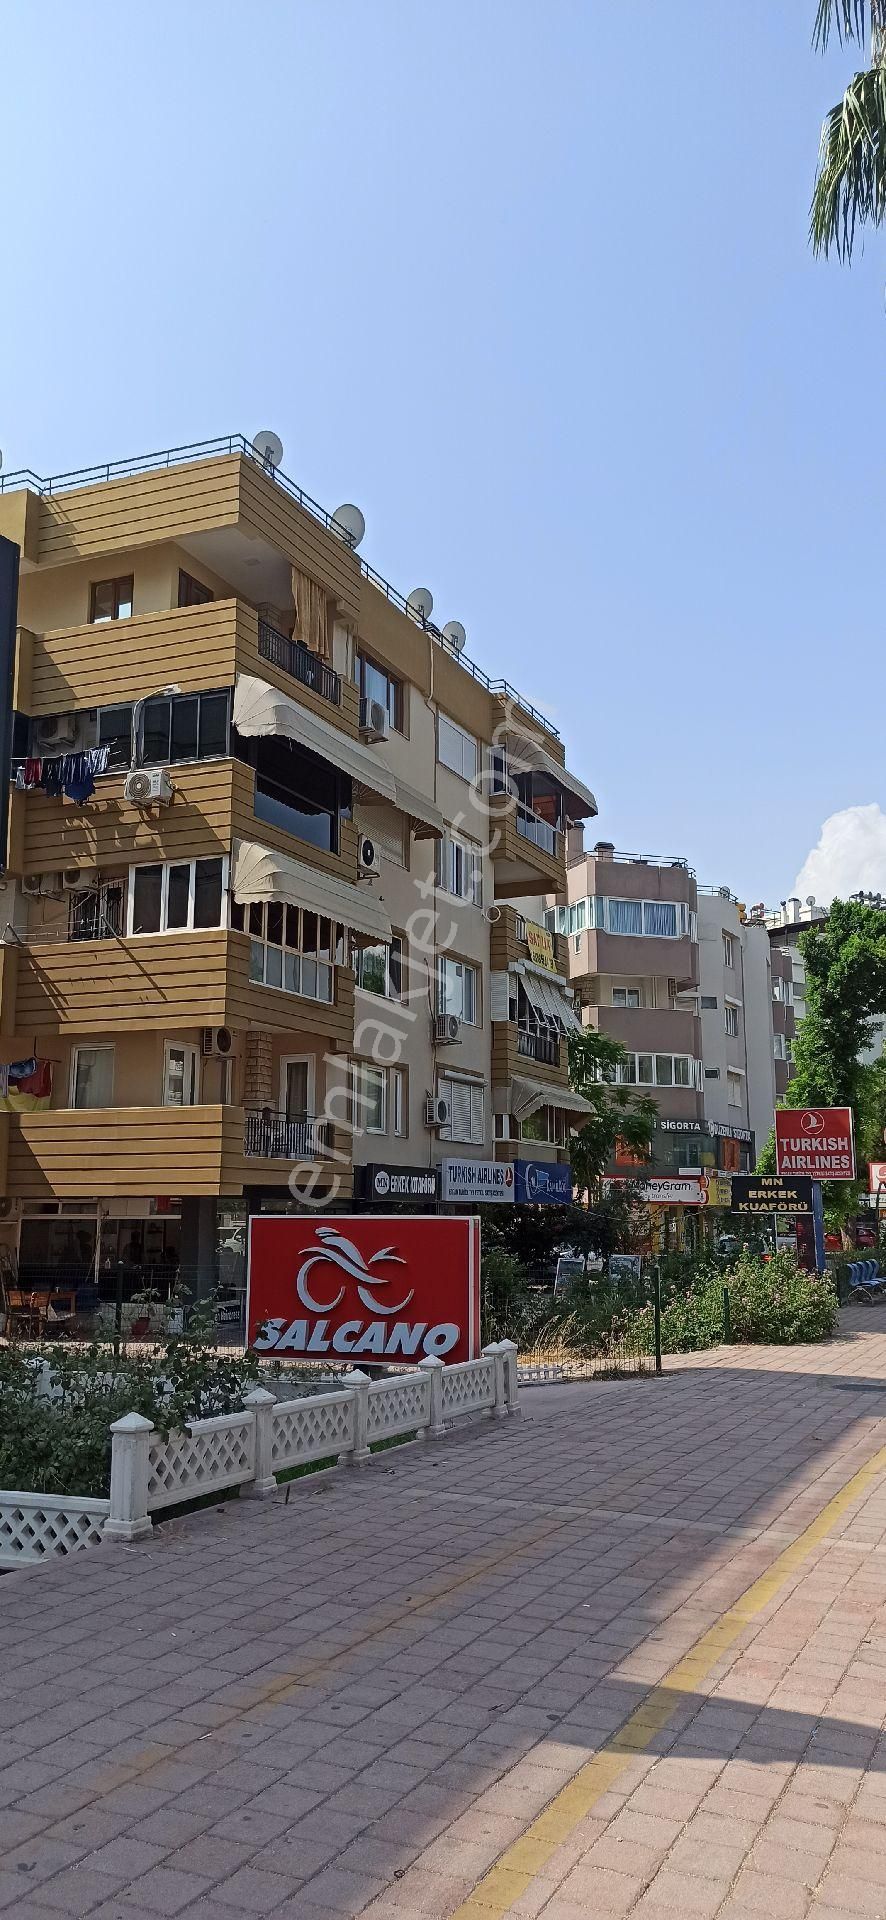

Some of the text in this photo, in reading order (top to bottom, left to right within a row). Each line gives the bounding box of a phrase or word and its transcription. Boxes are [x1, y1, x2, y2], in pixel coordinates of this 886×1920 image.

[661, 1120, 701, 1130] SİGORTA
[780, 1137, 848, 1152] TURKISH
[781, 1155, 850, 1169] AIRLINES
[448, 1165, 504, 1185] TURKISH AIRLINES
[761, 1178, 783, 1186] MN
[391, 1175, 410, 1193] ERKEK
[748, 1190, 798, 1199] ERKEK
[738, 1201, 808, 1211] KUAFÖRÜ
[253, 1318, 460, 1356] SALCANO
